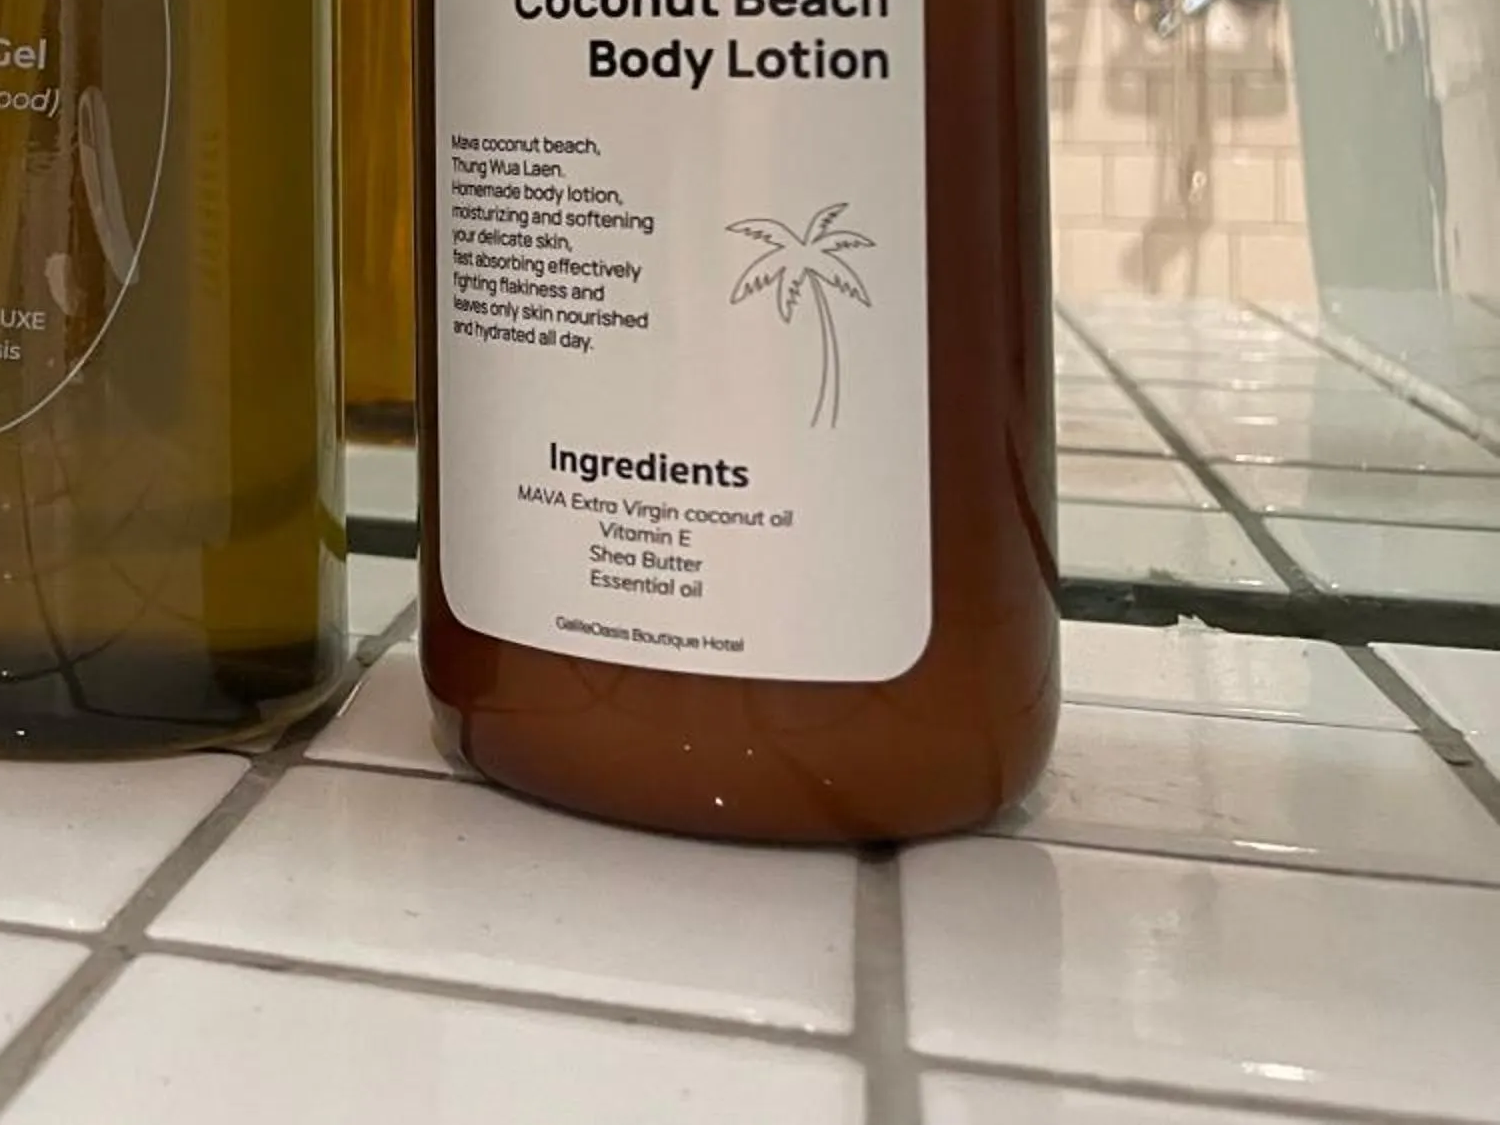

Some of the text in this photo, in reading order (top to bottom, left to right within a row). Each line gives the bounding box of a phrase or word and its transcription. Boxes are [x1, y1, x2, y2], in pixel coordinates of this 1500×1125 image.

[589, 39, 890, 90] Body Lotion
[451, 134, 601, 156] Mava coconut beach,
[452, 157, 488, 179] Thung
[489, 159, 521, 176] Wua
[452, 180, 623, 206] Homemade body lotion,
[452, 205, 655, 235] moisturizing and softening
[452, 228, 573, 253] your delicate skin,
[453, 249, 642, 283] fast absorbing effectively
[453, 271, 605, 302] fighting flakiness and
[453, 295, 649, 329] leaves only skin nourished
[453, 320, 595, 353] and hydrated all day.
[550, 442, 750, 488] Ingredients
[518, 484, 794, 528] MAVA Extra Virgin coconut oil
[599, 522, 692, 547] Vitamin E
[589, 545, 703, 573] Shea Butter
[589, 569, 703, 598] Essential oil
[632, 629, 700, 652] Boutique
[702, 636, 744, 653] Hotel
